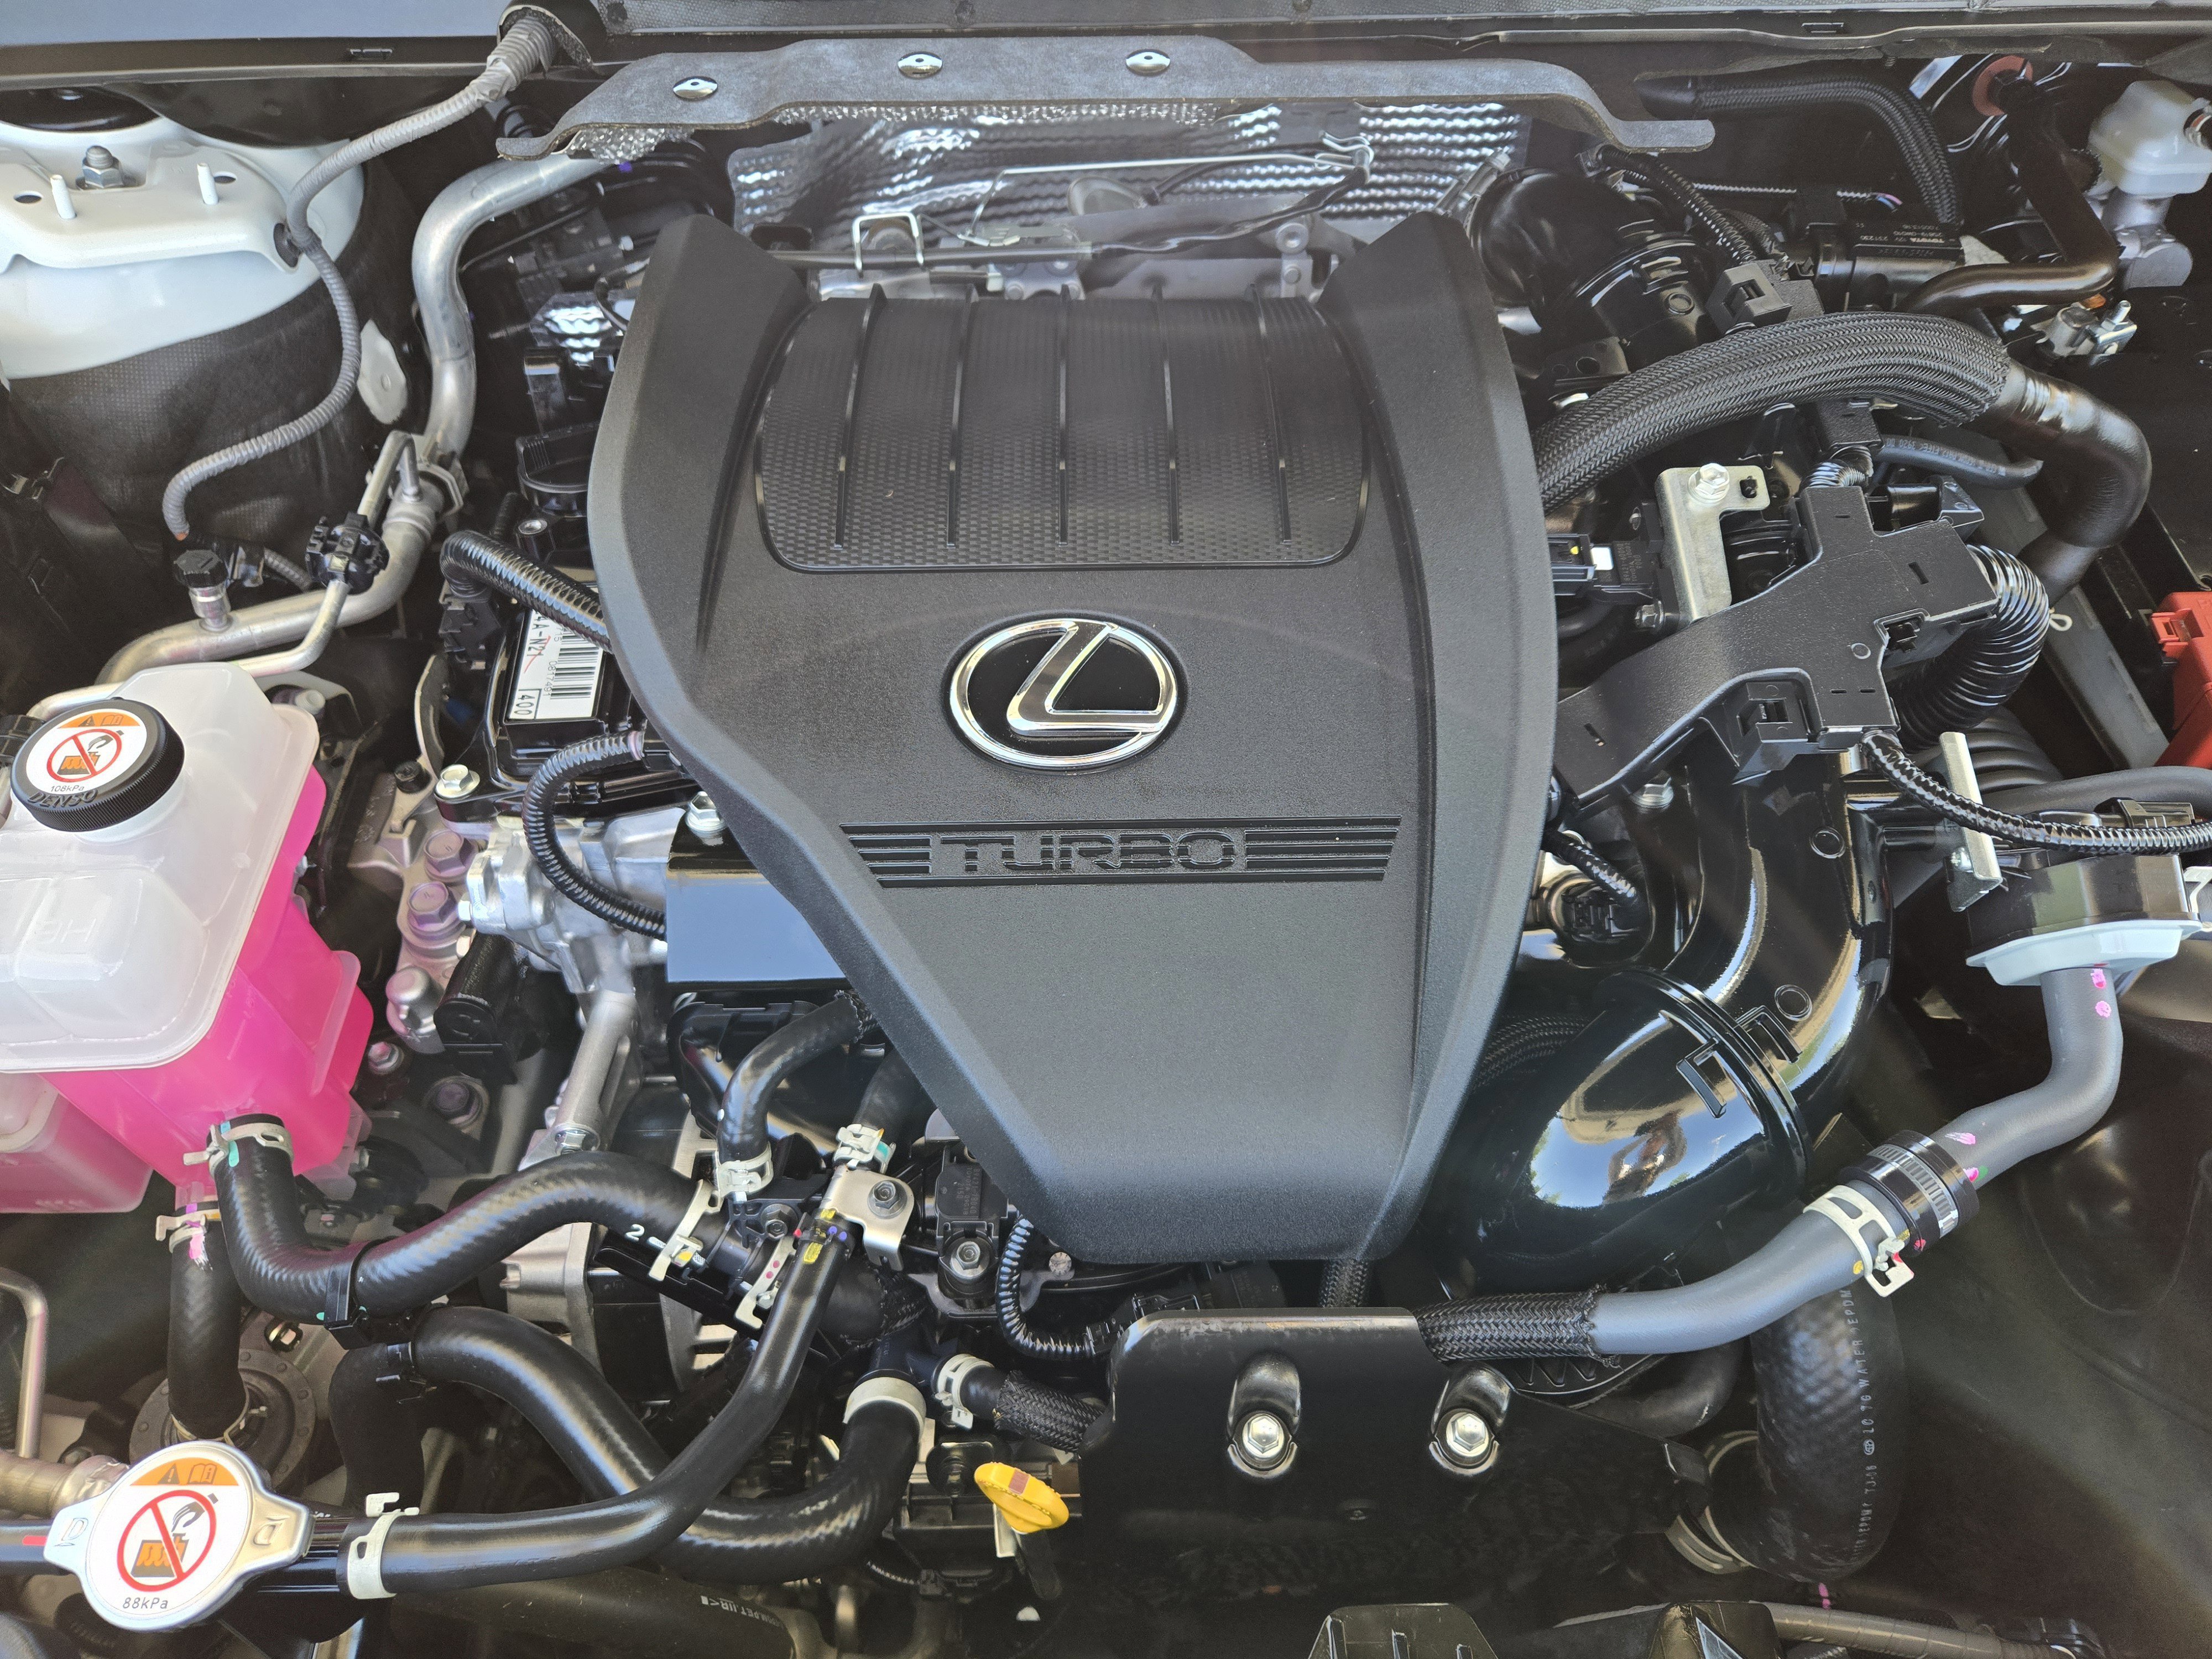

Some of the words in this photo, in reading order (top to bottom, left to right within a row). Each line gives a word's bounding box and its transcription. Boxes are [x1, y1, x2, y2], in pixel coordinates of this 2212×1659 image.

[526, 611, 550, 657] 4A-N21
[542, 660, 557, 697] 0817491
[514, 693, 535, 716] 400
[27, 789, 98, 808] DENSO
[941, 830, 1238, 872] TURBO
[625, 1223, 645, 1242] 2
[1852, 1340, 1870, 1388] WATER
[122, 1597, 168, 1609] 88kPa
